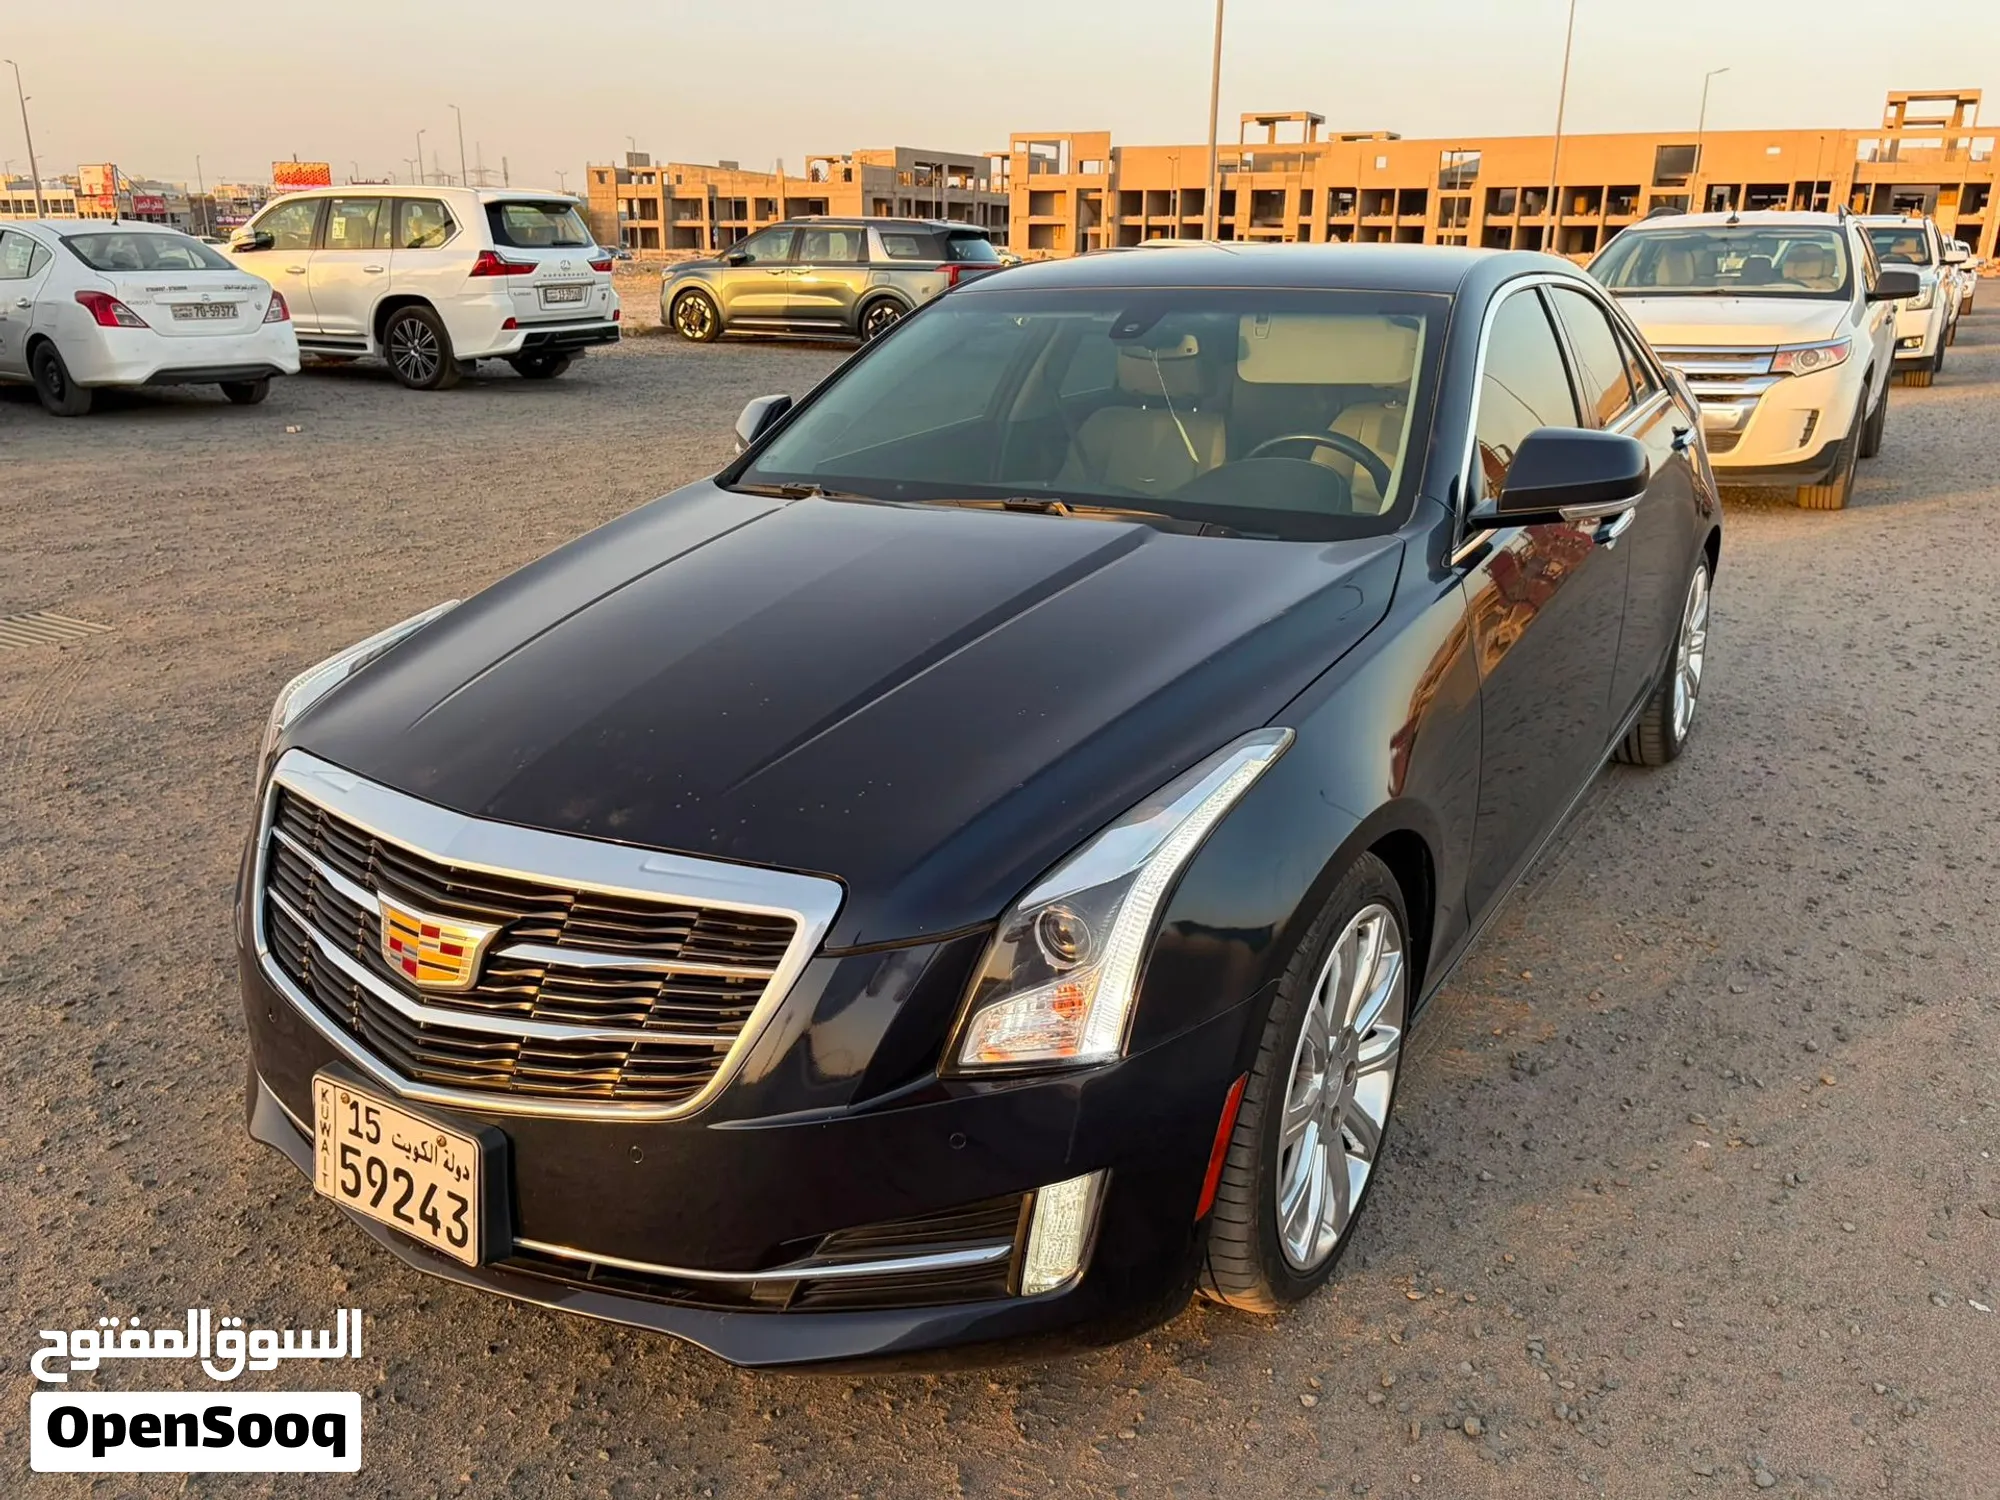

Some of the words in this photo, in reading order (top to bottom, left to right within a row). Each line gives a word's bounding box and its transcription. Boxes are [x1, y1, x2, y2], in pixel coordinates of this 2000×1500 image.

[319, 1087, 332, 1188] KUWAIT
[348, 1100, 381, 1145] 15
[391, 1132, 438, 1167] الكويت
[442, 1148, 470, 1183] دولة
[340, 1141, 469, 1249] 59243
